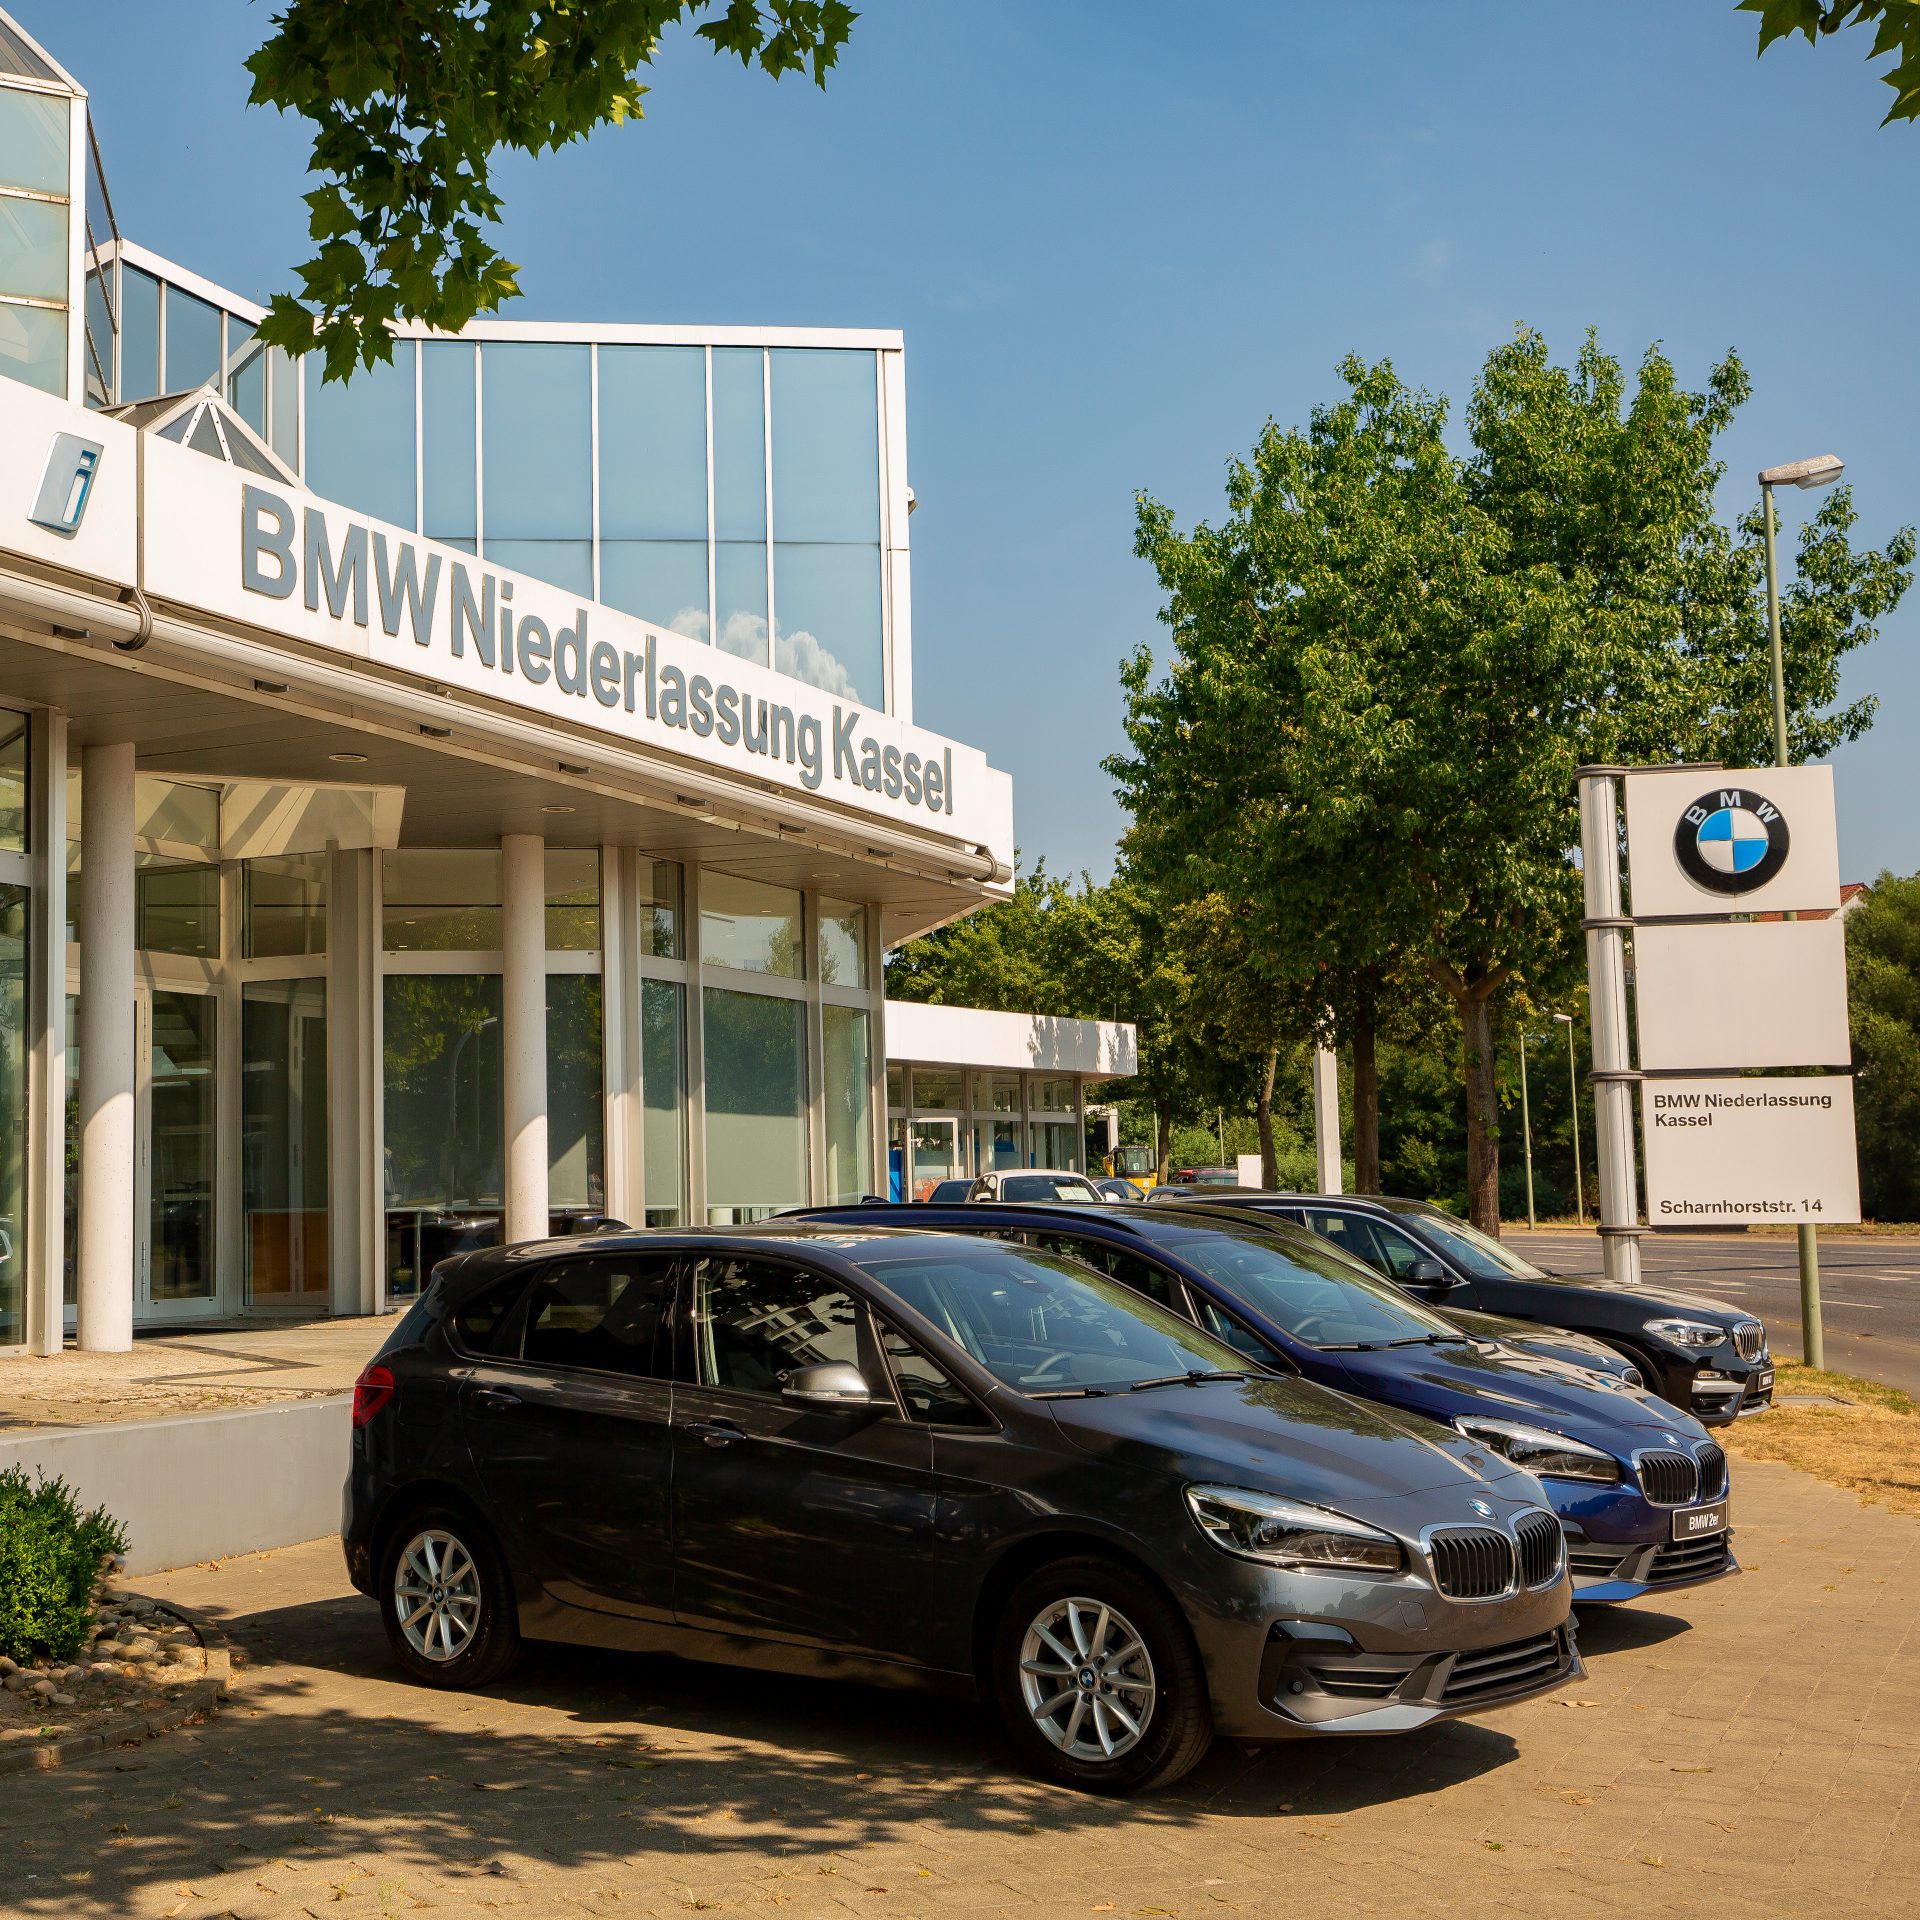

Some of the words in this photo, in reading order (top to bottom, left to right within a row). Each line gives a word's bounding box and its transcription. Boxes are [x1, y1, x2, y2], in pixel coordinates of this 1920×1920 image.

[241, 483, 443, 648] BMW
[450, 560, 823, 790] Niederlassung
[832, 704, 953, 815] Kassel
[1684, 790, 1780, 827] BMW
[1654, 1094, 1701, 1109] BMW
[1704, 1092, 1832, 1109] Niederlassung
[1655, 1112, 1713, 1127] Kassel
[1659, 1199, 1796, 1214] Scharnhorststr.
[1801, 1199, 1823, 1213] 14
[1689, 1514, 1709, 1531] BMW
[1709, 1512, 1719, 1527] 2er
